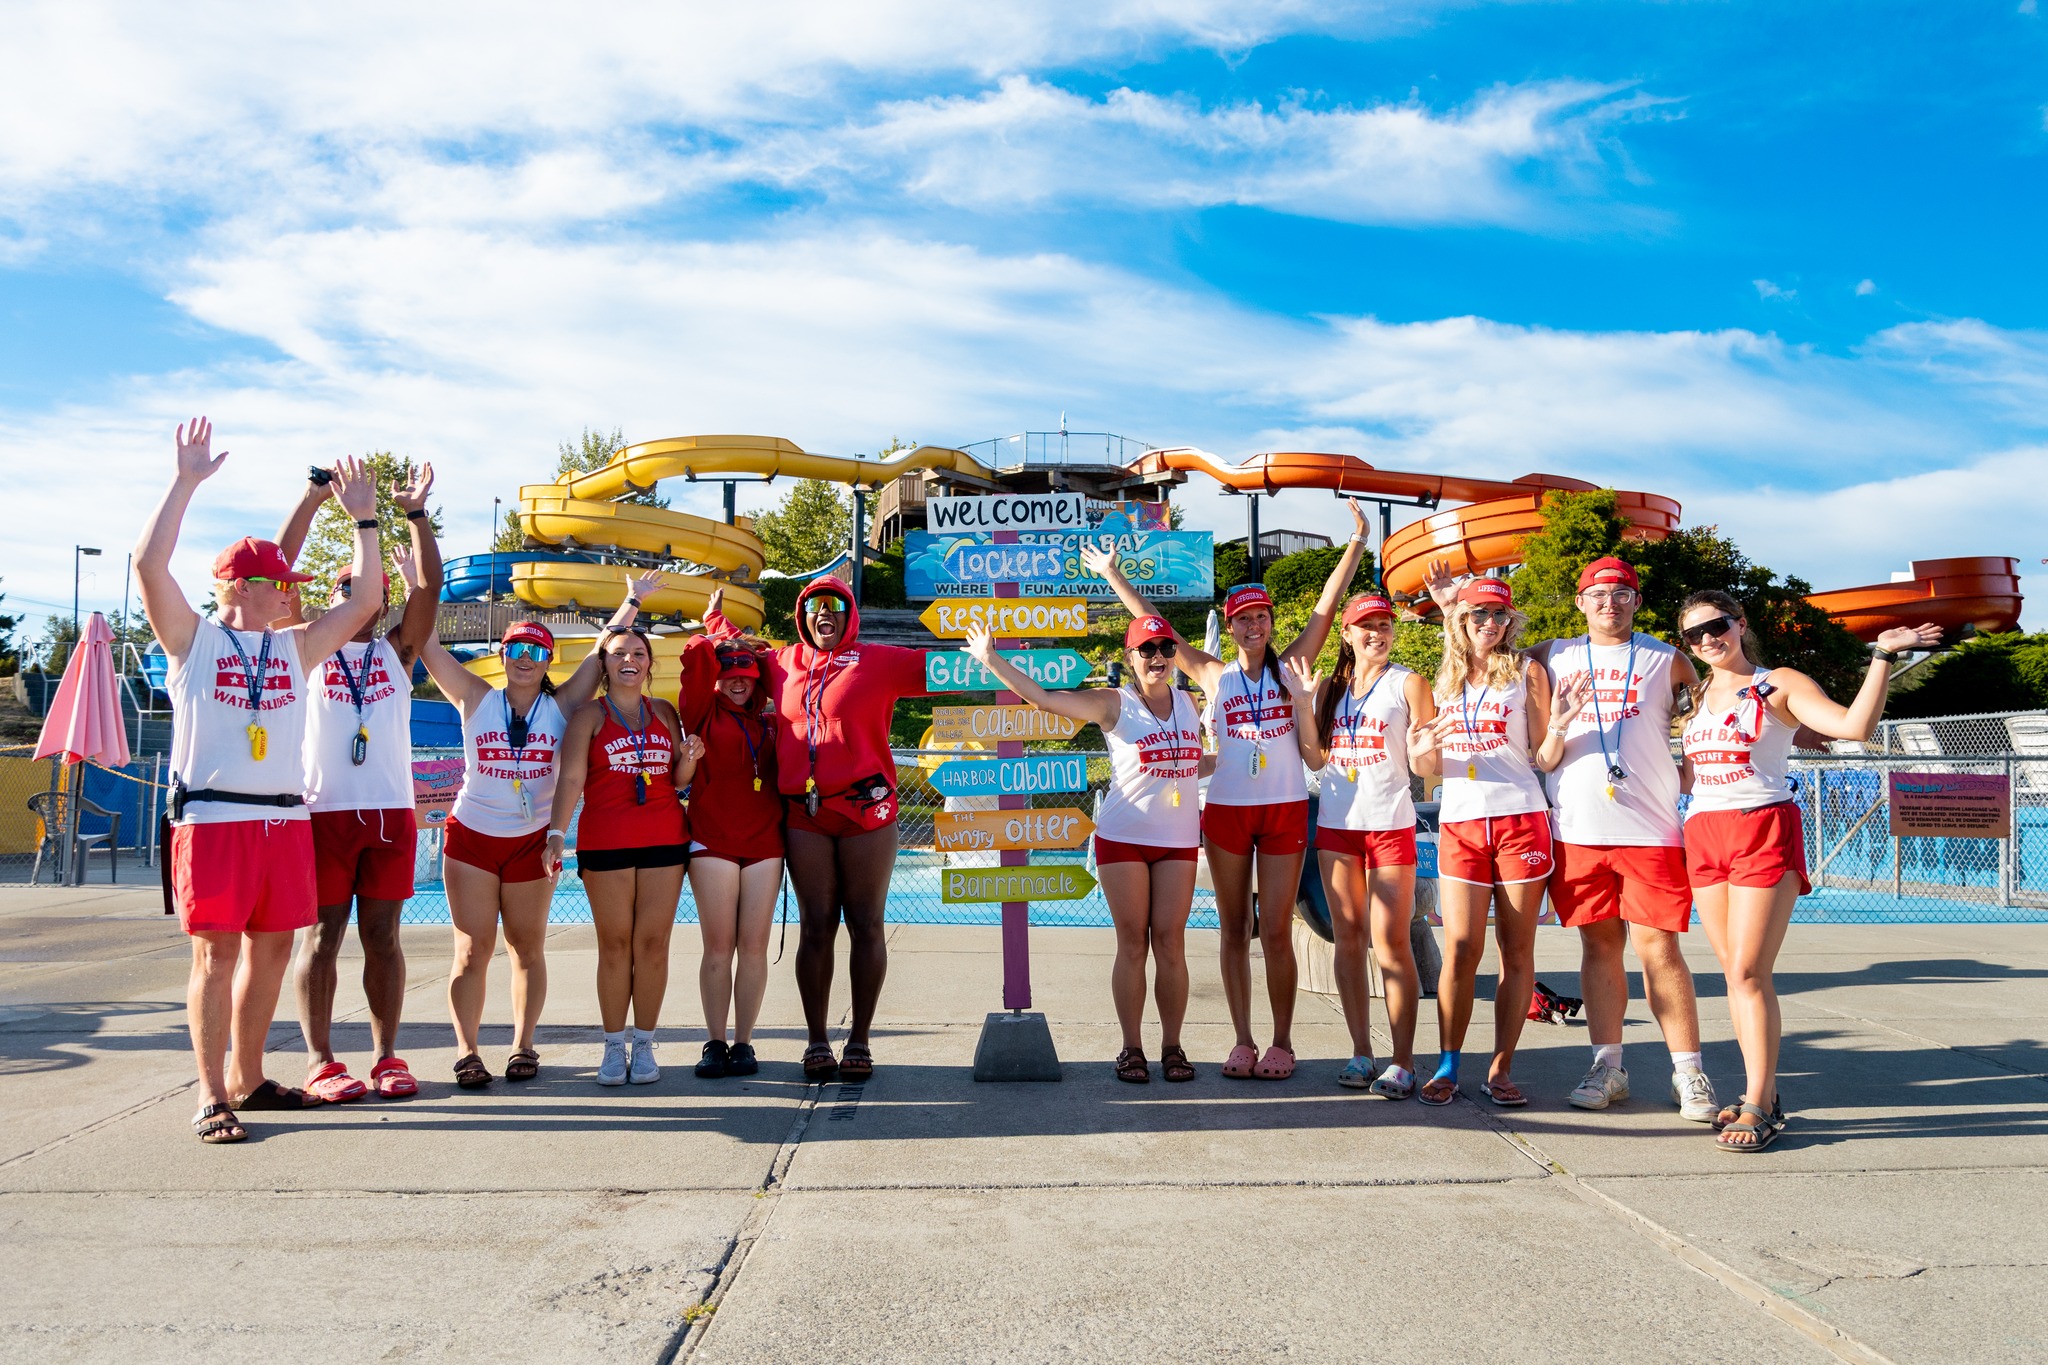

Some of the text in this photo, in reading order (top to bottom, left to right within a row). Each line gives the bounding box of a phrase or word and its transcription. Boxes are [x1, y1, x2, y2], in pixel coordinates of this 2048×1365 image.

[936, 584, 988, 594] WHERE
[1024, 584, 1054, 594] FUN
[1135, 584, 1178, 595] HINES!
[1234, 592, 1264, 605] LIFEGUARD
[930, 655, 990, 686] Gift
[213, 688, 296, 711] WATESLIDES
[1223, 693, 1263, 713] BIRCH
[1481, 701, 1513, 719] BAY
[1227, 720, 1294, 743] WATERSLIDES
[1361, 715, 1389, 733] BAY
[475, 731, 558, 747] BIRC BAY
[604, 734, 671, 755] BIRCH BAY
[1135, 730, 1178, 751] BIRCH
[498, 750, 532, 759] STAFF
[630, 752, 658, 761] SAFF
[1162, 749, 1190, 759] STAFF
[1329, 751, 1387, 768] ATERSLIDES
[1696, 752, 1723, 762] STAFF
[477, 762, 553, 780] WATERSLIDES
[942, 769, 996, 787] HARBOR
[1139, 764, 1198, 779] WATERSLIDE
[1895, 782, 1923, 793] BIRCH
[1924, 784, 1943, 793] BAY
[952, 812, 975, 822] THE
[937, 828, 995, 849] hungry
[1520, 851, 1547, 860] GUARD
[949, 872, 1077, 899] Barrrnacle
